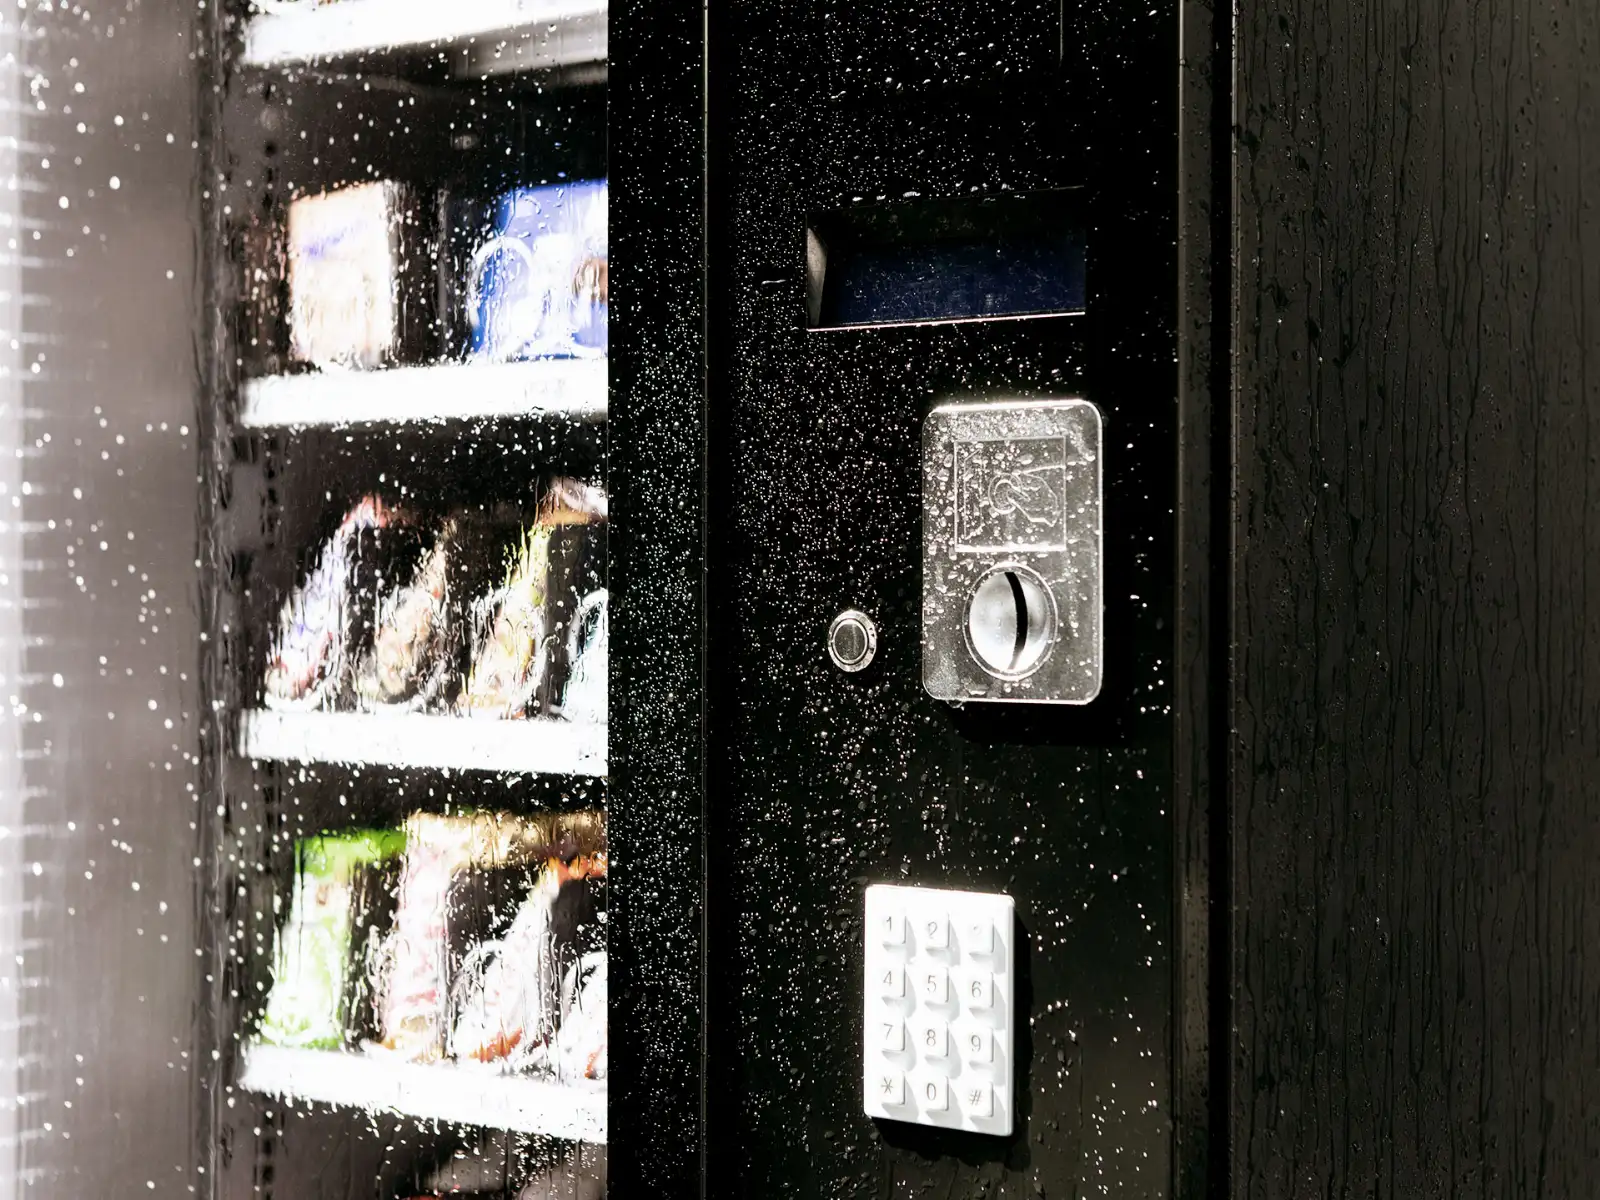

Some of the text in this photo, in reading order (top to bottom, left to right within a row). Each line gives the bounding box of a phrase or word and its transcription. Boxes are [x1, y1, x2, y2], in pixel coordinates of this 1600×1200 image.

[885, 915, 938, 937] 1 2
[882, 970, 982, 999] 4 5 6
[883, 1022, 982, 1053] 7 8 9
[925, 1082, 937, 1102] 0
